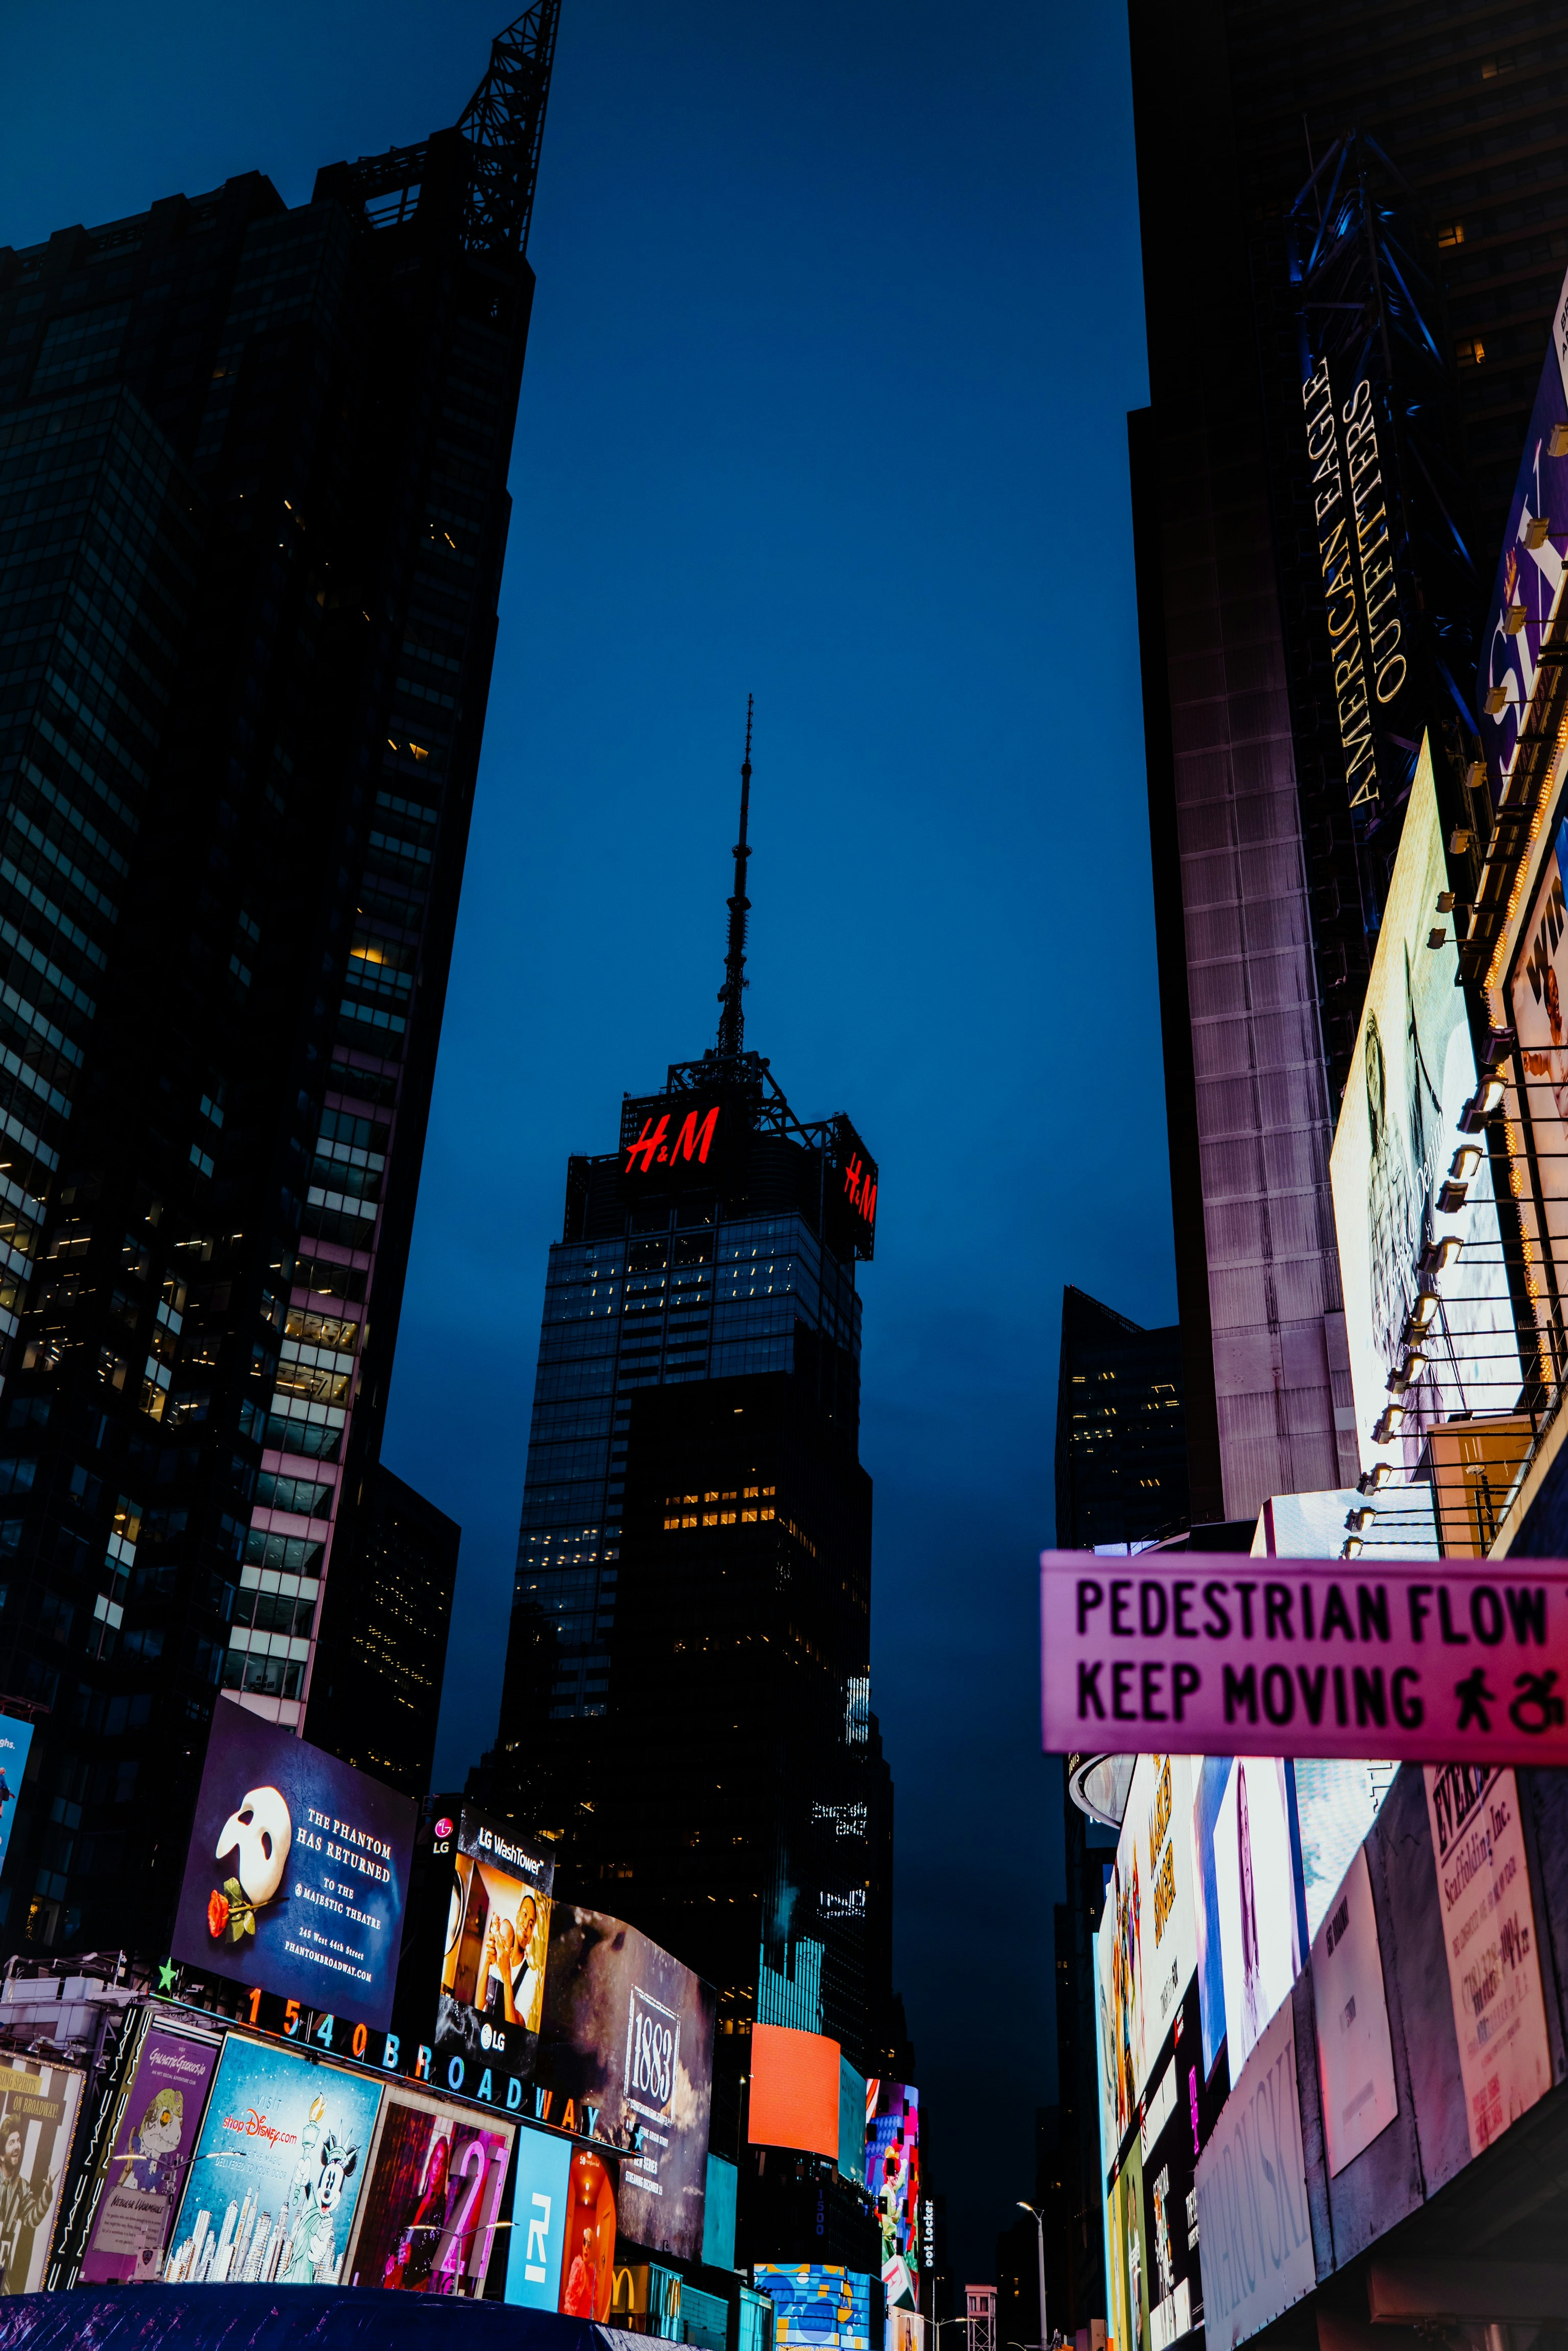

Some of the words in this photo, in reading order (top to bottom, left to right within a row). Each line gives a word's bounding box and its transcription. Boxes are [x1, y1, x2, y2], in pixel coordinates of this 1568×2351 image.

[1303, 356, 1343, 526] EAGLE
[1343, 379, 1407, 703] OUTFITTERS
[1319, 517, 1379, 809] AMERICAN
[625, 1107, 720, 1173] H&M
[1415, 1111, 1446, 1216] Denim
[844, 1153, 877, 1223] H&M
[1075, 1579, 1392, 1643] PEDESTRIAN
[1407, 1585, 1548, 1647] FLOW
[1076, 1660, 1202, 1723] KEEP
[1222, 1662, 1425, 1729] MOVING
[308, 1808, 331, 1830] THE
[332, 1819, 391, 1859] PHANTOM
[433, 1842, 449, 1854] LG
[478, 1827, 492, 1850] LG
[296, 1827, 322, 1851] HAS
[326, 1842, 390, 1882] RETURNED
[1444, 1828, 1493, 1913] Scaffolding
[1489, 1801, 1511, 1843] Inc.
[324, 1877, 335, 1890] TO
[337, 1883, 354, 1899] THE
[303, 1888, 343, 1913] MAJESTIC
[346, 1906, 381, 1930] THEATRE
[284, 1941, 372, 1982] PHANTOMBROADWAY.COM
[299, 1927, 311, 1938] 245
[314, 1932, 328, 1946] West
[329, 1939, 344, 1952] 44th
[346, 1946, 364, 1960] Street
[492, 2030, 506, 2051] LG
[631, 2012, 673, 2103] 1883
[174, 2075, 189, 2084] ADVENTURE
[249, 1988, 368, 2056] 1540
[384, 2034, 600, 2137] BROADWAY
[14, 2075, 37, 2093] SPIRITS
[257, 2094, 282, 2113] VISIT
[13, 2096, 23, 2111] ON
[22, 2098, 59, 2118] BROADWAY!
[215, 2157, 244, 2171] DELIVERED
[247, 2163, 254, 2173] TO
[255, 2165, 270, 2176] YOUR
[272, 2170, 287, 2179] DOOR
[254, 2149, 263, 2161] THE
[265, 2154, 282, 2166] MAGIC
[643, 2157, 657, 2175] SERIES
[625, 2170, 644, 2187] STREAMING
[643, 2178, 659, 2194] DECEMBER
[111, 2194, 135, 2209] NEBULAR
[135, 2198, 164, 2214] WORMHOLE
[440, 2141, 509, 2280] 21
[816, 2189, 824, 2236] 1500
[923, 2245, 934, 2267] oot
